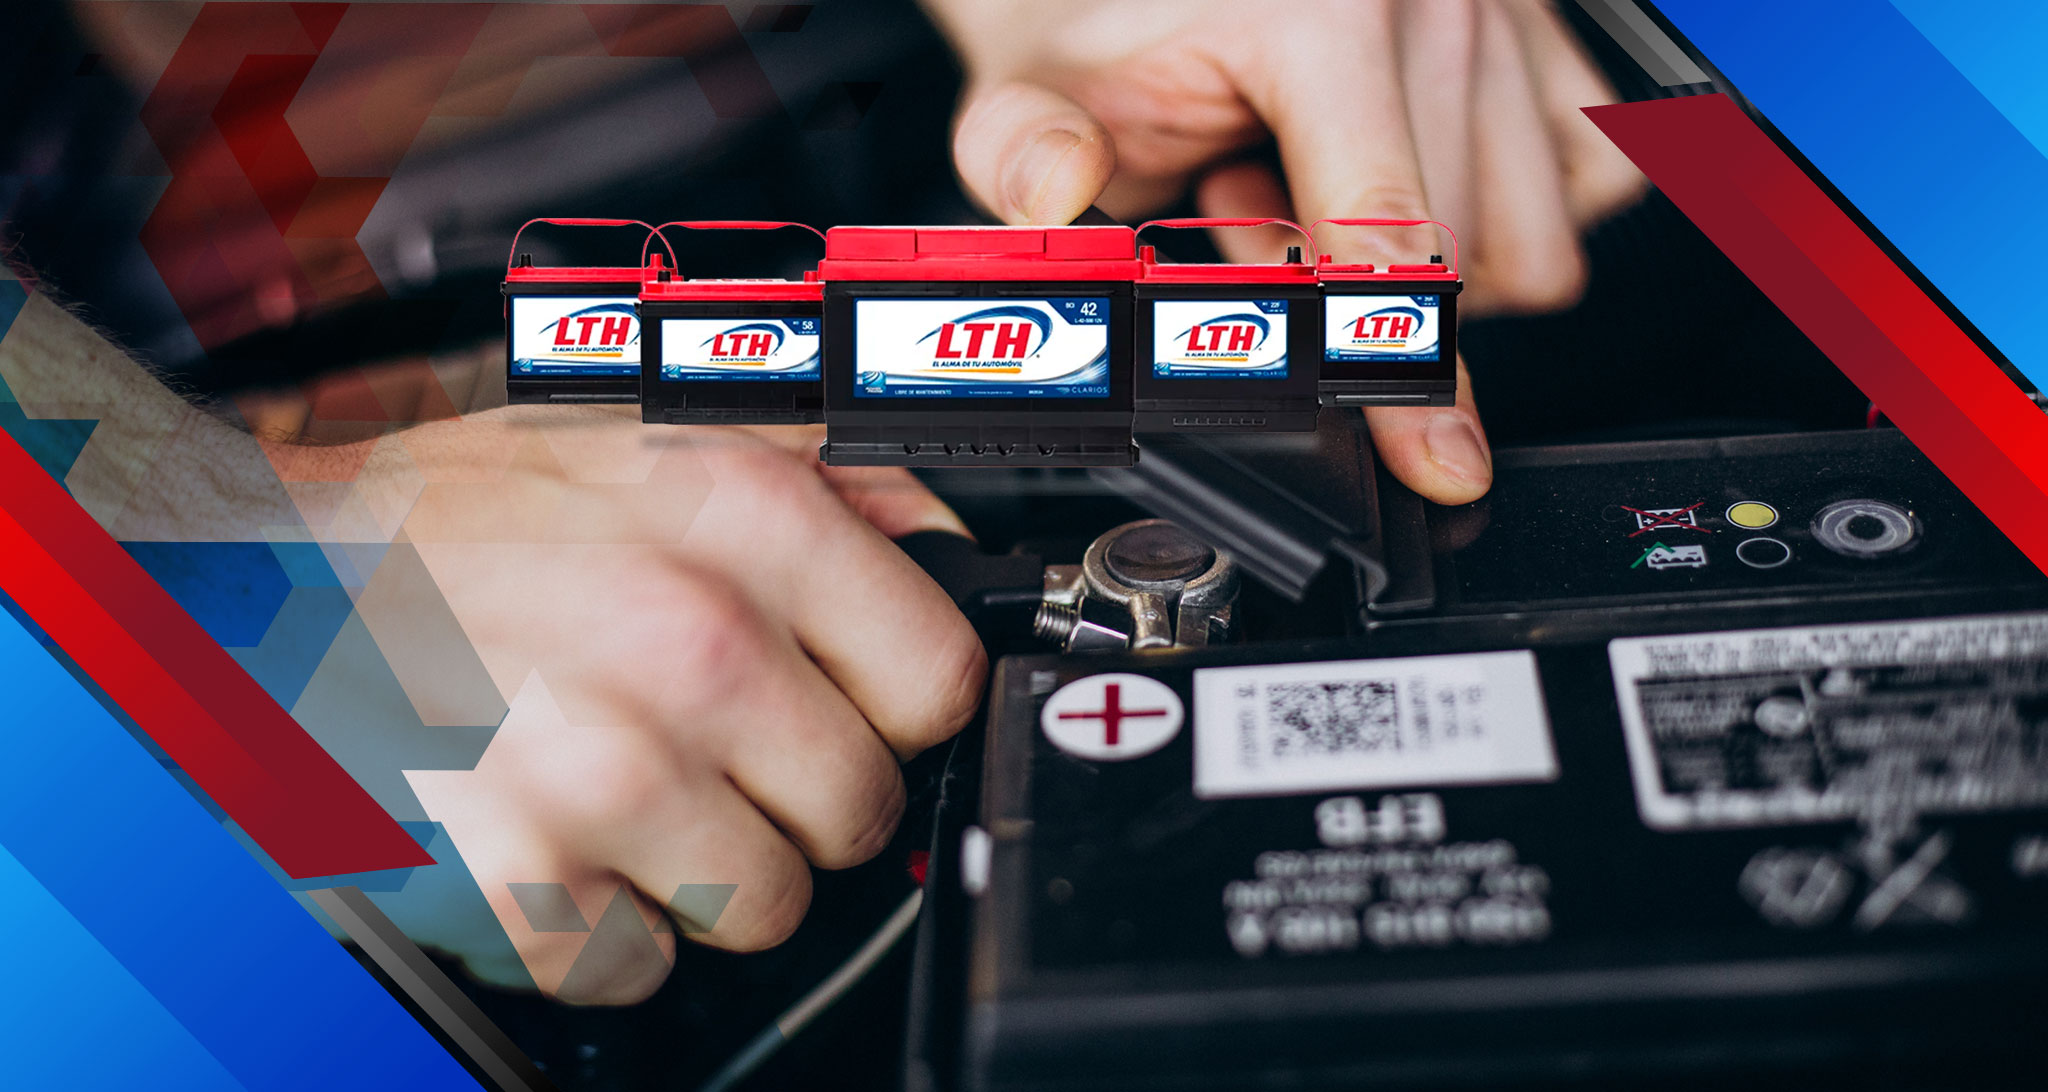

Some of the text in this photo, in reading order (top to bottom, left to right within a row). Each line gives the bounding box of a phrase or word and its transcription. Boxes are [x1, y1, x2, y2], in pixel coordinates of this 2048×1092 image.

[1080, 302, 1097, 316] 42
[554, 317, 632, 346] LTH
[802, 320, 814, 330] 58
[1353, 316, 1412, 338] LTH
[711, 334, 772, 356] LTH
[934, 323, 1032, 358] LTH
[1187, 326, 1256, 351] LTH
[1071, 386, 1108, 394] CLARIOS
